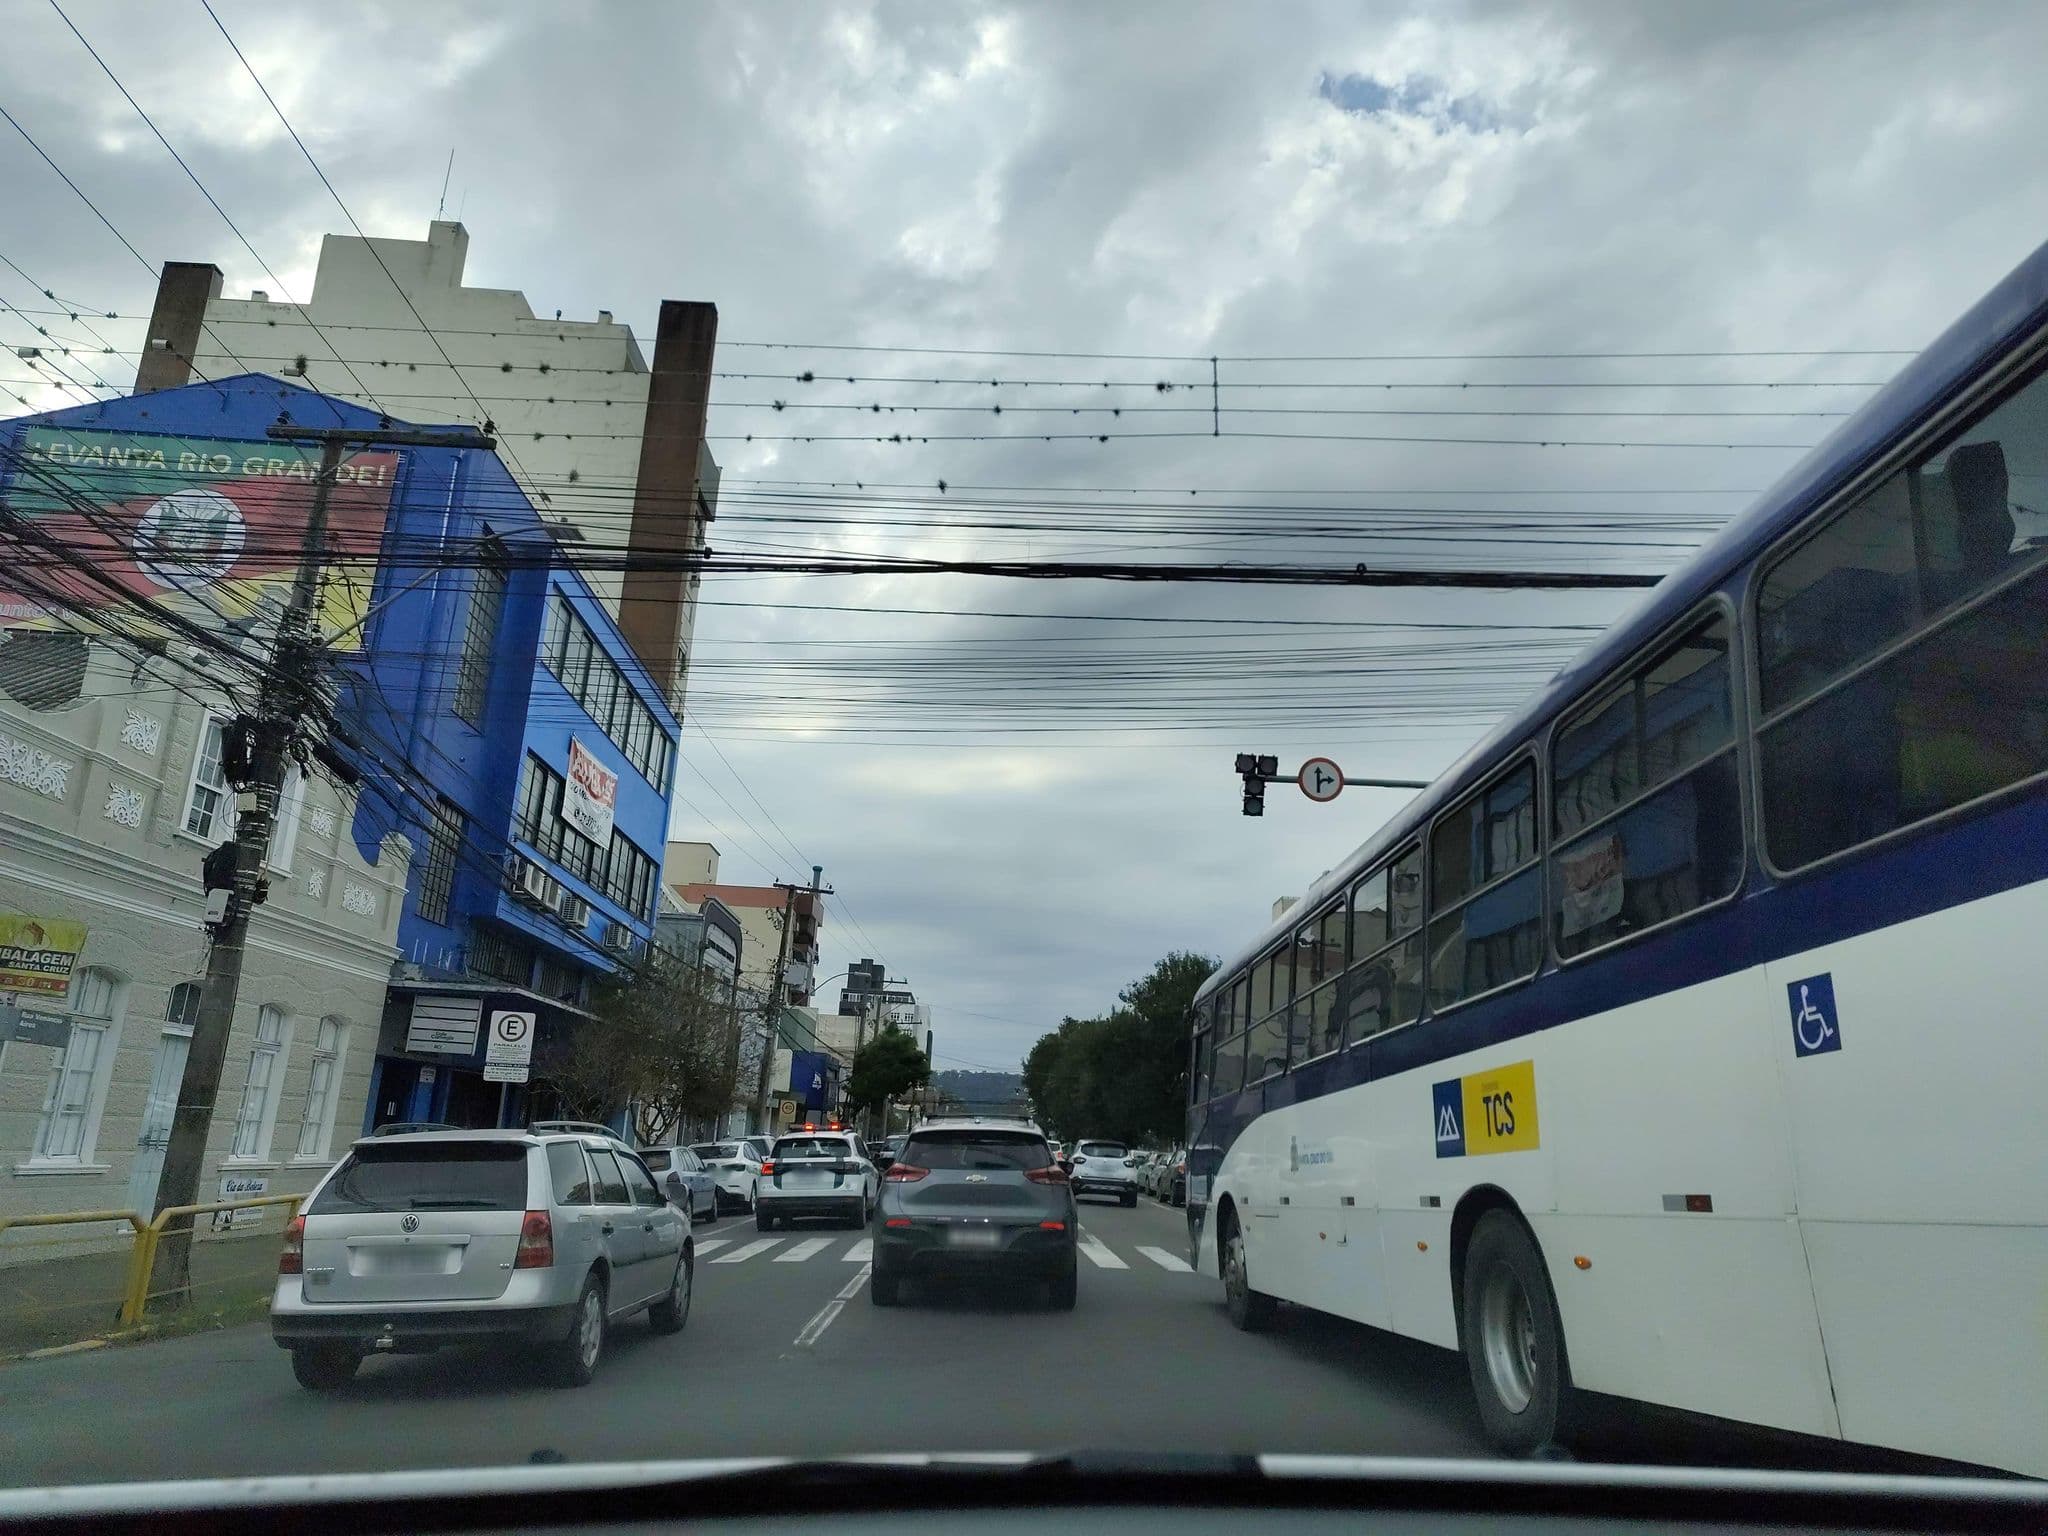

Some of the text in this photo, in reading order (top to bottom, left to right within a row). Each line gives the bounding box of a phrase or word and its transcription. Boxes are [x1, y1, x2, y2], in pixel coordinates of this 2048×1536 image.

[31, 442, 168, 470] LEVANTA
[178, 452, 232, 474] RIO
[0, 947, 73, 966] BALAGEM
[8, 961, 70, 974] SANTA CRUZ
[506, 1020, 519, 1036] E
[1483, 1091, 1515, 1137] TCS
